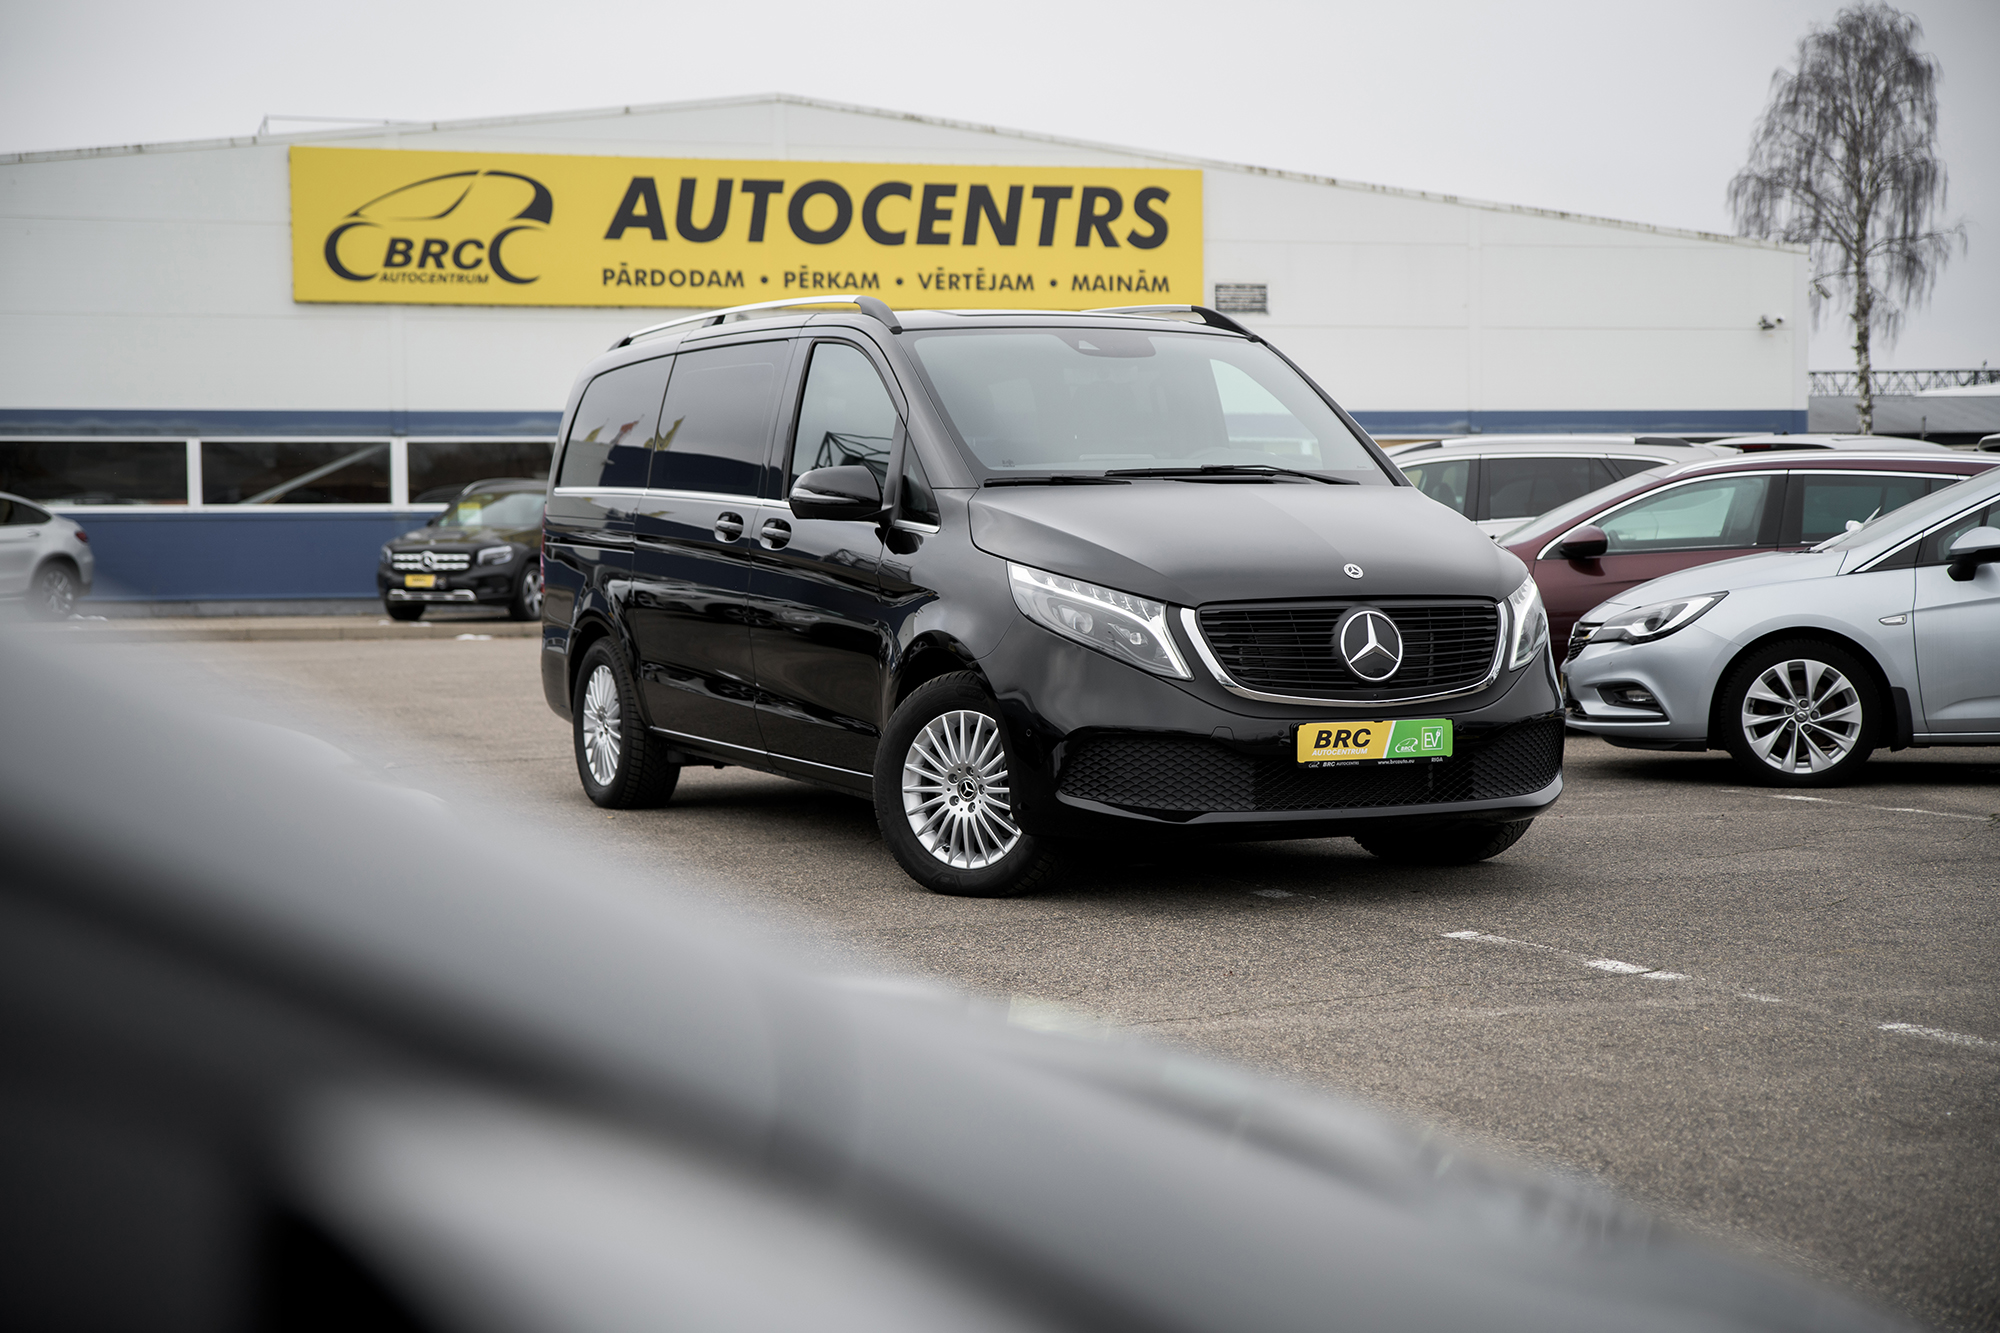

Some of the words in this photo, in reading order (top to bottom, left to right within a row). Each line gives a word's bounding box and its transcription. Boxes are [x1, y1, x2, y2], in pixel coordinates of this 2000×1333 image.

[602, 175, 1171, 250] AUTOCENTRS
[383, 237, 486, 271] BRC
[379, 270, 490, 286] AUTOCENTRUM
[602, 261, 745, 288] PĀRDODAM
[783, 264, 881, 290] PĒRKAM
[917, 266, 1035, 292] VĒRTĒJAM
[1071, 268, 1170, 293] MAINĀM
[1313, 728, 1372, 749] BRC
[1424, 730, 1441, 748] EV
[1311, 748, 1368, 756] AUTOCENTRUM
